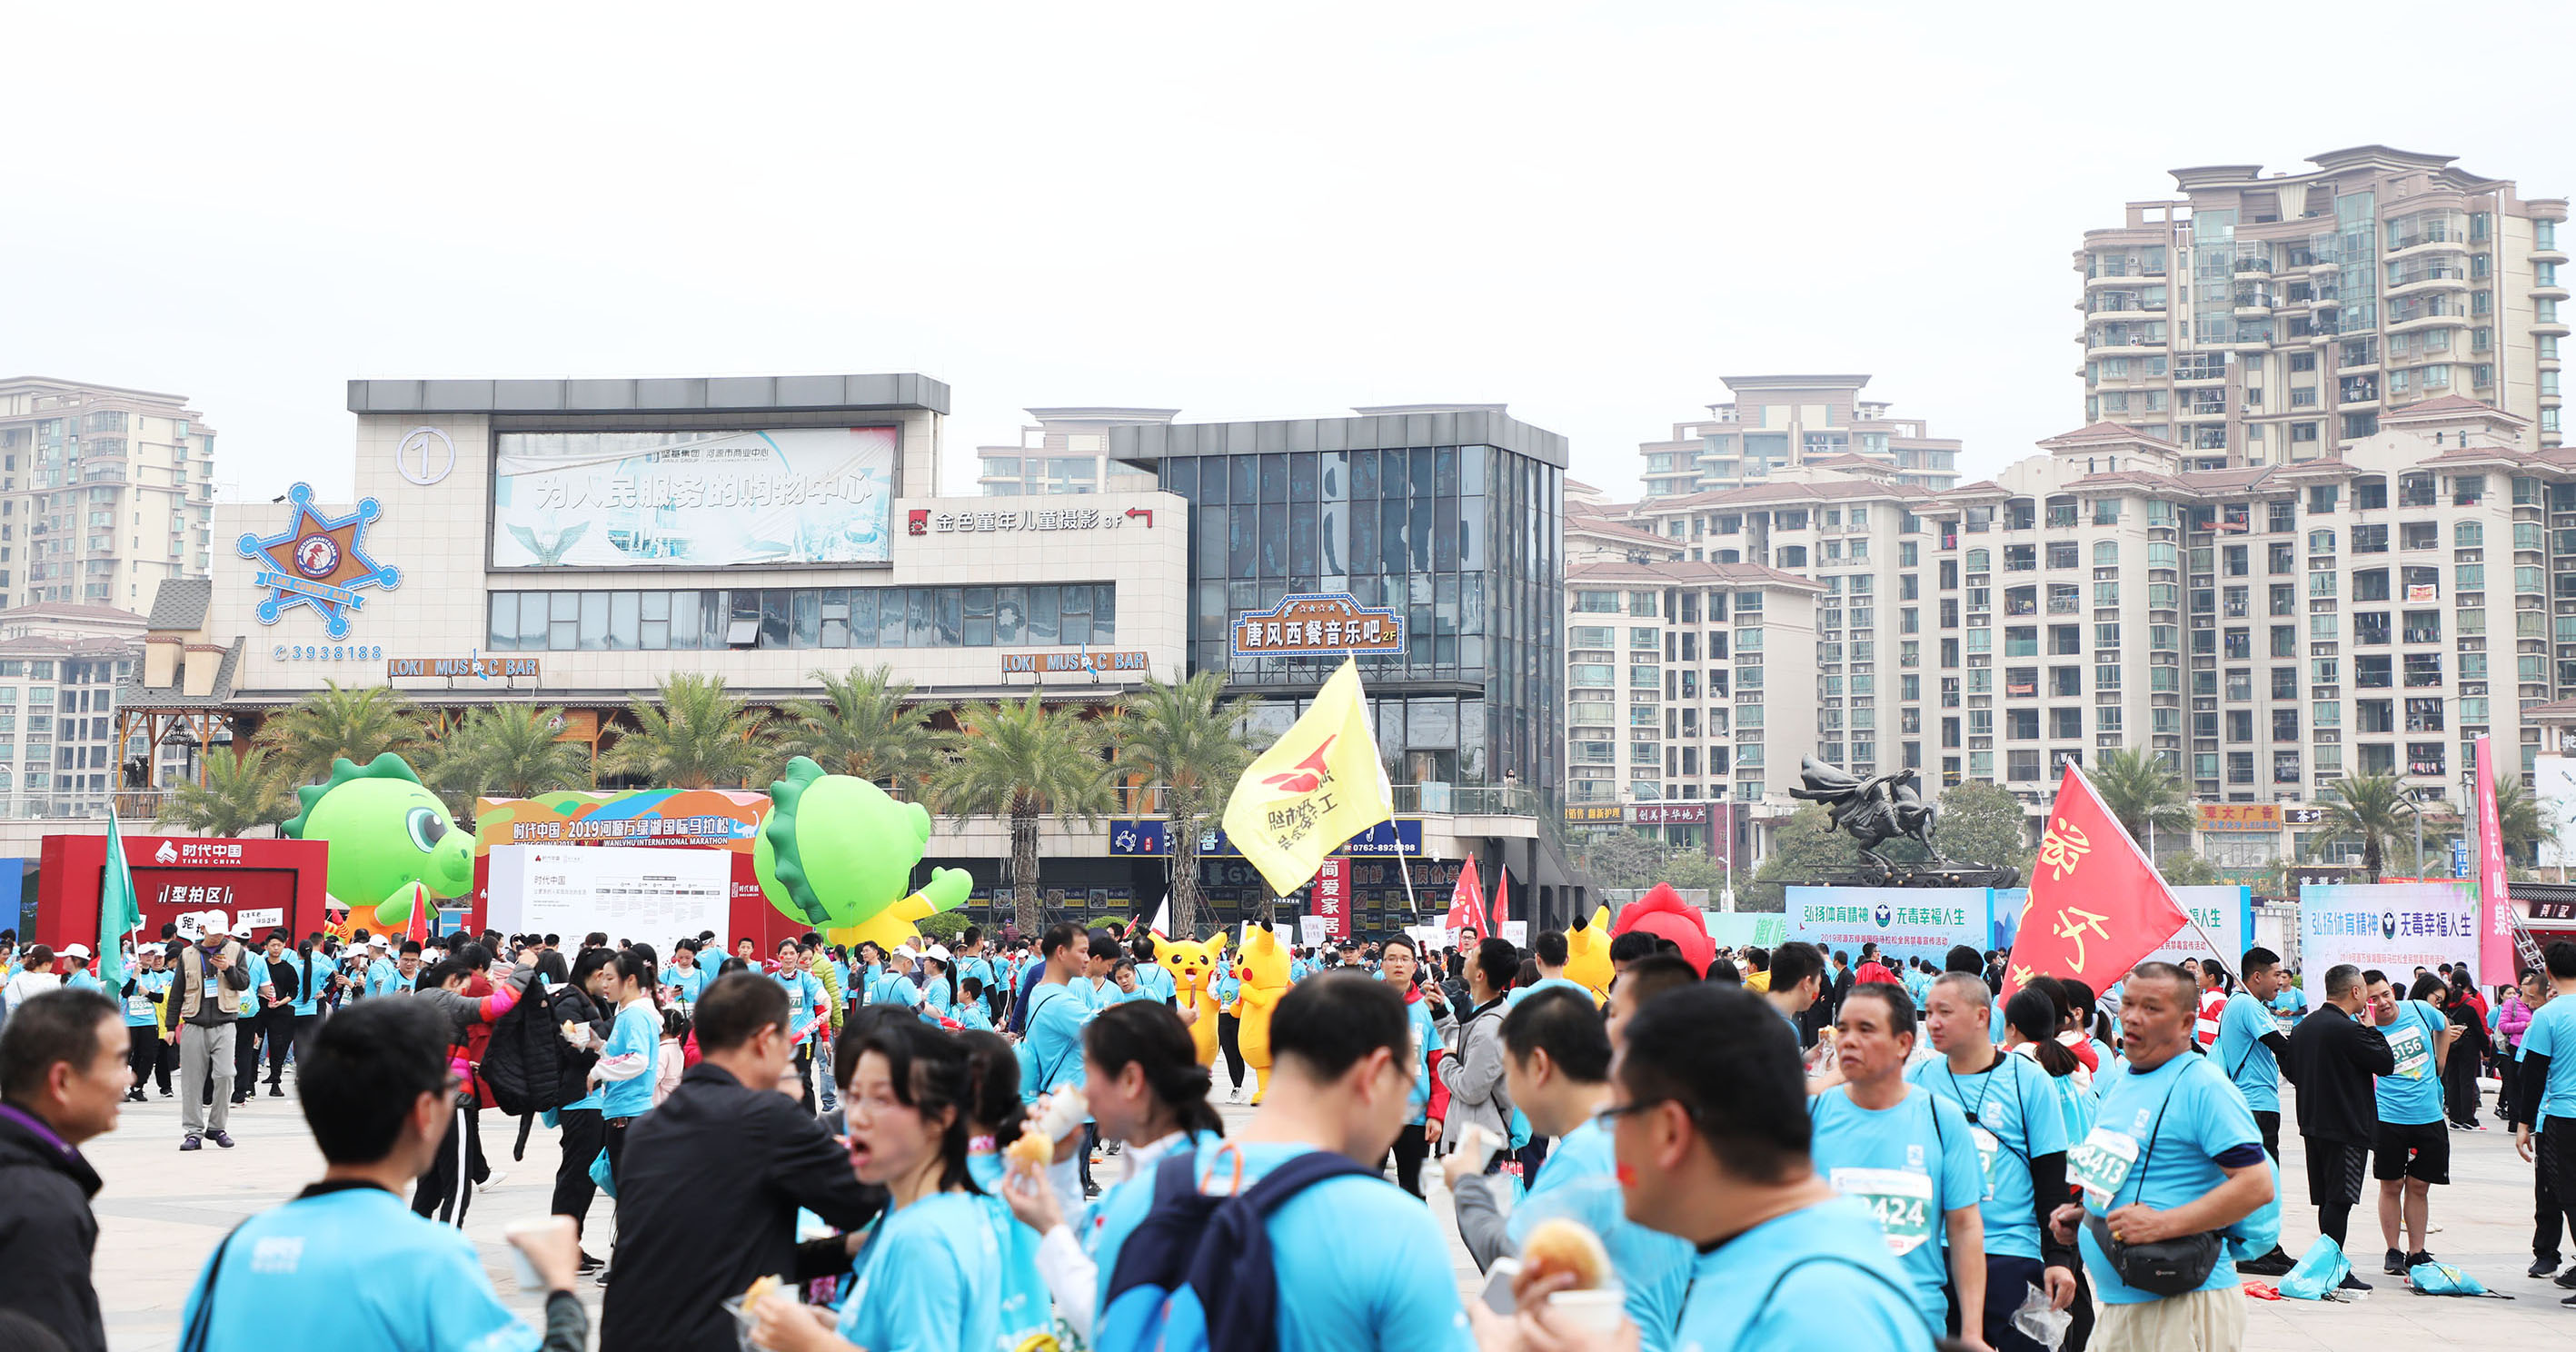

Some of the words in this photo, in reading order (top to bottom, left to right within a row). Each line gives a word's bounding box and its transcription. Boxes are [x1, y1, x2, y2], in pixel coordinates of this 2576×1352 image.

[536, 472, 872, 510] 为人民服务的购物中心
[936, 509, 1099, 532] 金色童年儿童摄影
[1104, 515, 1123, 529] 3F
[270, 574, 291, 587] LOKI
[293, 580, 329, 596] COWBOY
[333, 590, 351, 601] BAR
[1245, 619, 1381, 648] 唐风西餐音乐吧
[1382, 631, 1397, 641] 2F
[292, 645, 383, 661] 3938188
[1002, 653, 1036, 671] LOKI
[1114, 651, 1145, 670] BAR
[390, 660, 424, 676] LOKI
[505, 659, 536, 676] BAR
[182, 843, 243, 858] 时代中国
[637, 837, 689, 846] INTERNATIONAL
[689, 836, 728, 846] MARATHON
[533, 875, 566, 886] 时代中国
[170, 885, 223, 904] 型拍区
[1320, 860, 1339, 933] 简爱家居
[1804, 905, 1869, 924] 弘扬体育精神
[1896, 907, 1965, 926] 无毒幸福人生
[2312, 911, 2379, 937] 弘扬体育精神
[2401, 911, 2472, 938] 无毒幸福人生
